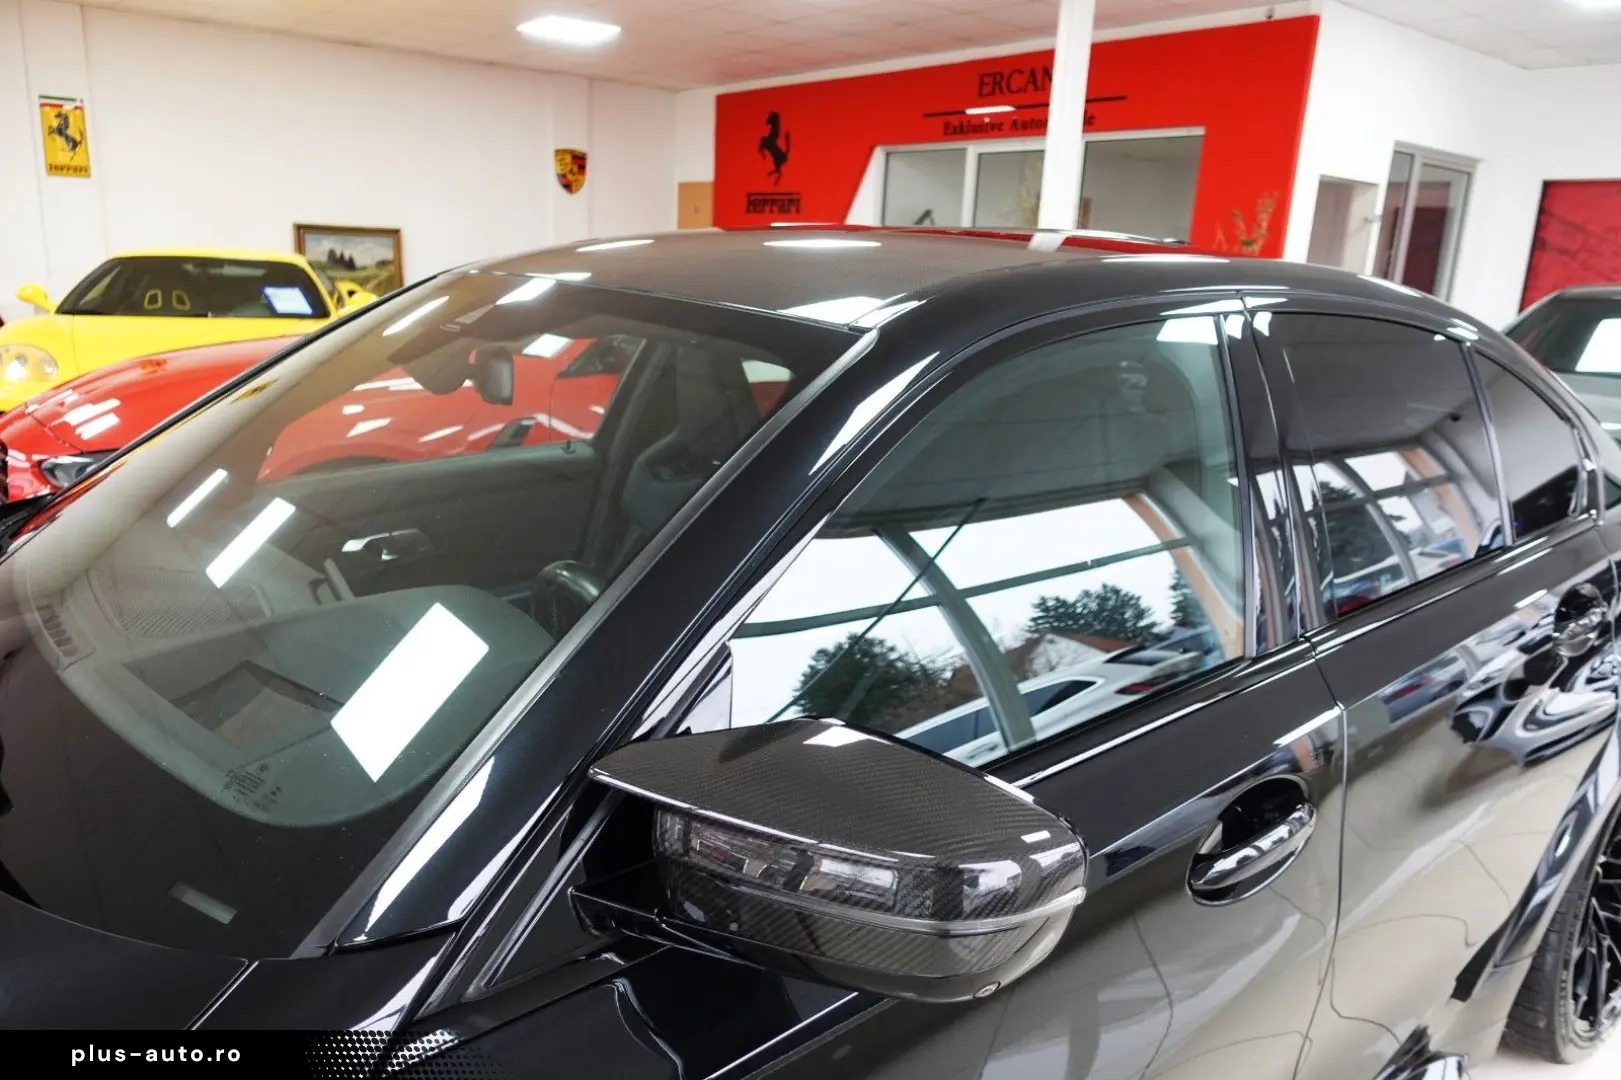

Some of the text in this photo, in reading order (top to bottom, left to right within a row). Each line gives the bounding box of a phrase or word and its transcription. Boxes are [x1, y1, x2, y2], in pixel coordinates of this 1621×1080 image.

[943, 109, 1096, 136] Exklusive Autole
[745, 192, 801, 214] Ferrari
